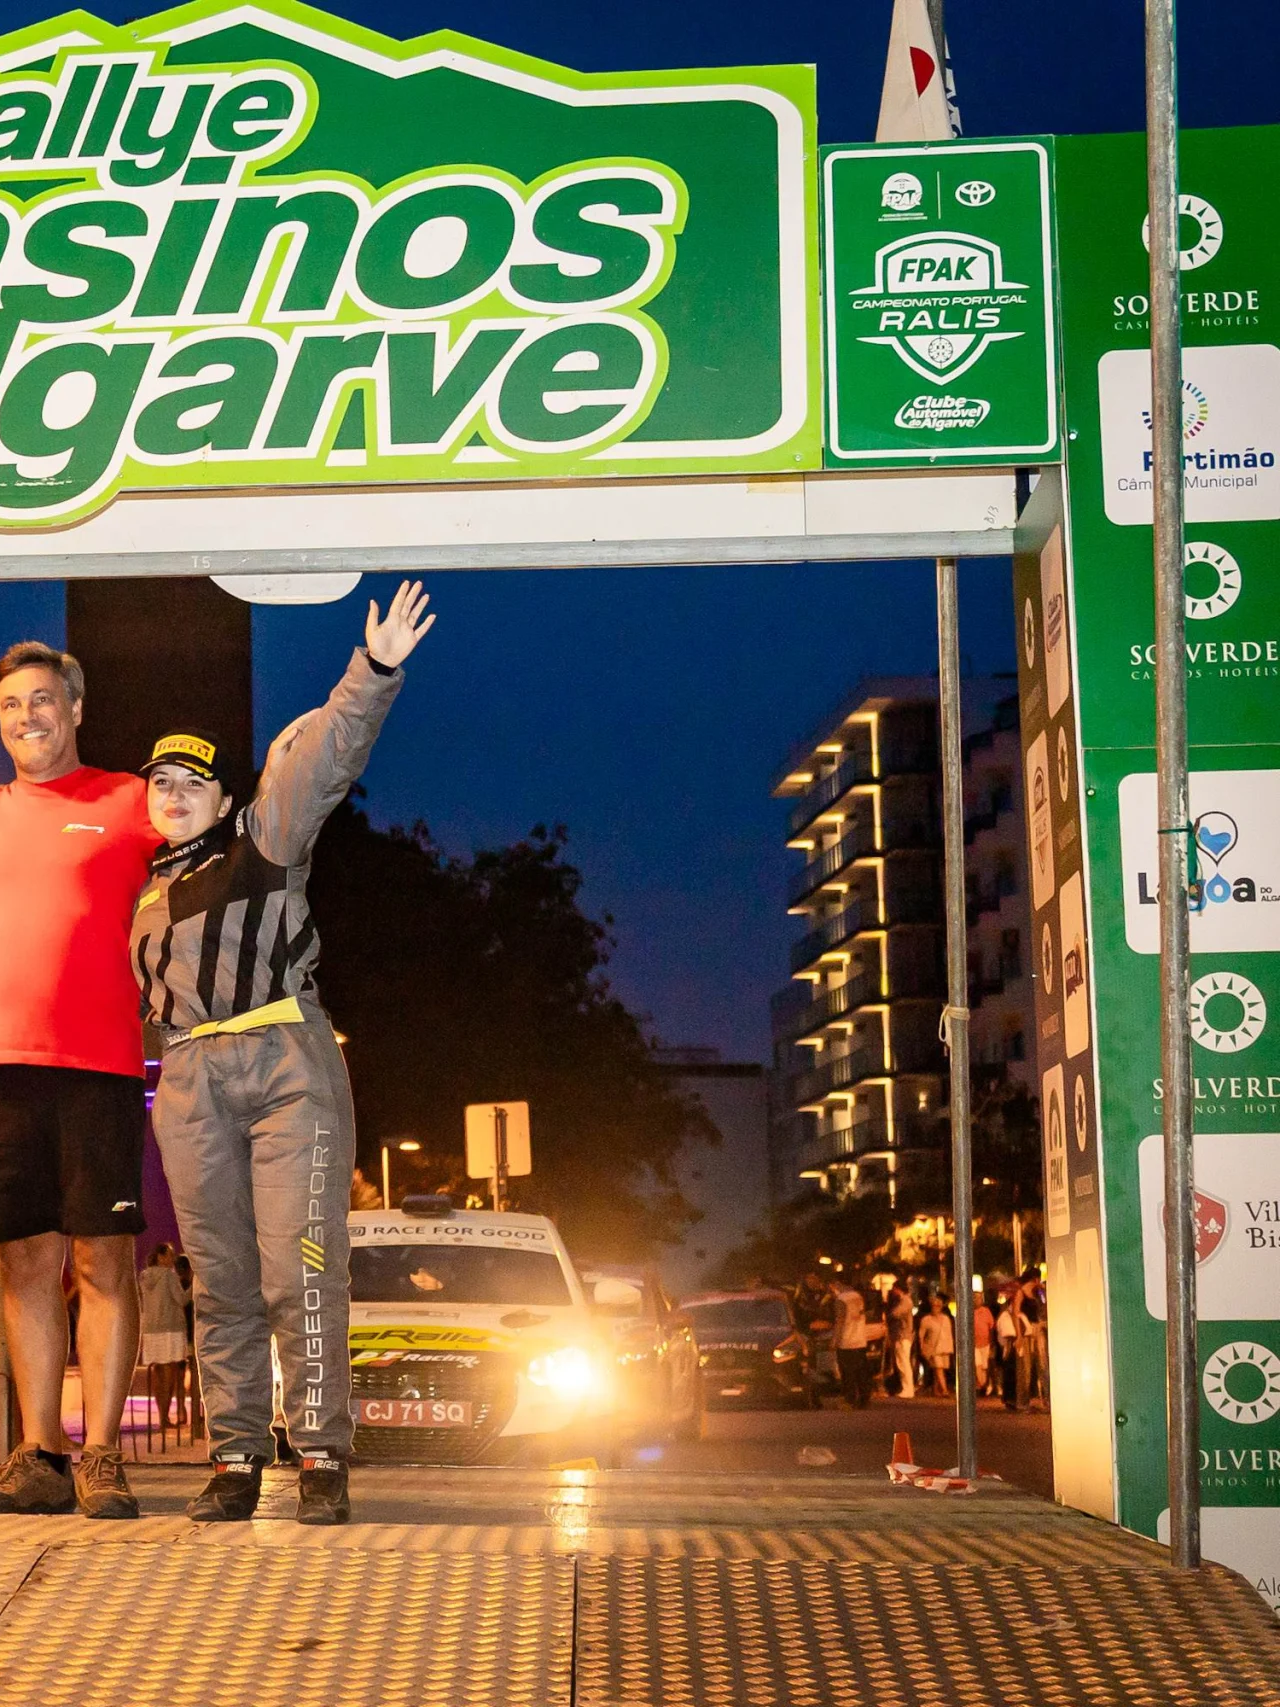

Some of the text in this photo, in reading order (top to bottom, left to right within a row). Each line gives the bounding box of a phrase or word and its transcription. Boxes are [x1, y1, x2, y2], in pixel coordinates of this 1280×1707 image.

[898, 255, 978, 283] FPAK
[852, 294, 1027, 309] CAMPEONATO PORTUGAL
[1113, 290, 1260, 316] SOERDE
[878, 307, 1001, 331] RALIS
[1201, 316, 1259, 327] HOTÉIS
[912, 395, 967, 409] Clube
[920, 417, 975, 432] Algarve
[1143, 447, 1275, 472] Prtimão
[1184, 474, 1258, 490] Municipal
[1130, 641, 1279, 666] SOVERDE
[1220, 666, 1278, 678] HOTÉIS
[158, 739, 211, 758] PIRELLI
[1138, 872, 1256, 912] Loa
[1153, 1077, 1280, 1100] SLVERD
[308, 1121, 331, 1245] SPORT
[373, 1226, 546, 1241] RACE FOR GOOD
[1245, 1227, 1280, 1248] Bi
[303, 1264, 324, 1431] PEUGEOT
[365, 1402, 465, 1422] CJ 71 SQ
[226, 1463, 253, 1474] RRS
[314, 1459, 339, 1471] RRS
